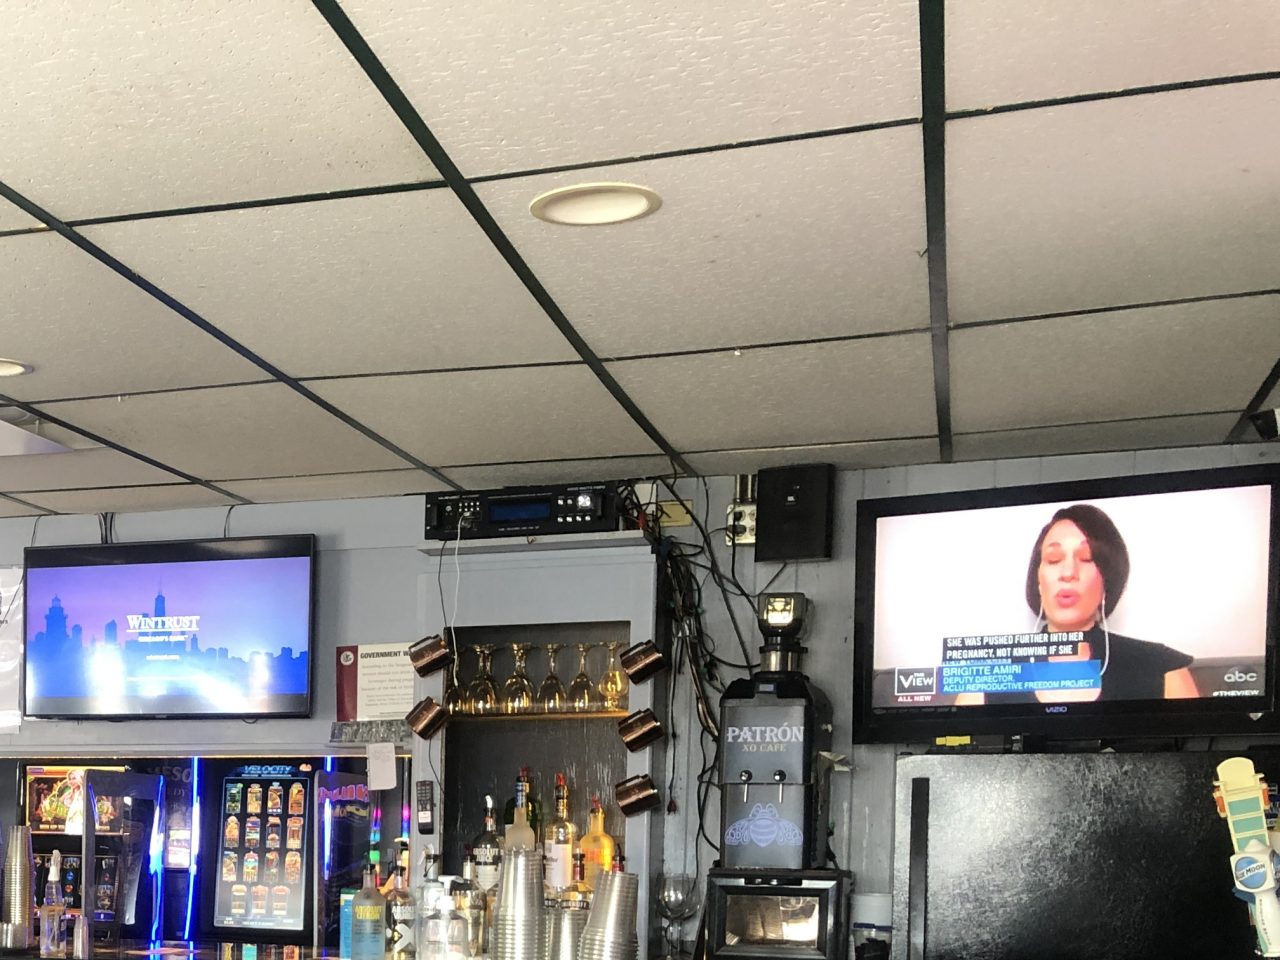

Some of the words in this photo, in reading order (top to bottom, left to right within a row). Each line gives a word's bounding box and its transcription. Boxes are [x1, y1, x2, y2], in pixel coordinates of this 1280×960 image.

[946, 638, 963, 647] SHE
[964, 637, 982, 646] WAS
[983, 635, 1013, 645] PUSHED
[1015, 633, 1049, 644] FURTHER
[1050, 632, 1067, 642] INTO
[1068, 632, 1084, 641] HER
[360, 650, 402, 659] GOVERNMENT
[946, 648, 994, 659] PREGNANCY,
[996, 647, 1012, 657] NOT
[1013, 646, 1048, 656] KNOWING
[1049, 645, 1056, 654] IF
[1058, 645, 1073, 655] SHE
[943, 665, 990, 676] BRIGITTE
[992, 665, 1022, 675] AMIRI
[1223, 670, 1258, 682] abc
[899, 674, 933, 689] VIEW
[943, 676, 974, 685] DEPUTY
[975, 675, 1015, 684] DIRECTOR,
[943, 684, 965, 692] ACLU
[966, 682, 1023, 692] REPRODUCTIVE
[1024, 680, 1060, 689] FREEDOM
[1060, 679, 1095, 688] PROJECT
[726, 722, 804, 743] PATRÓN
[741, 744, 757, 753] XO
[243, 765, 292, 774] VELOCITY
[1245, 863, 1266, 876] MOON
